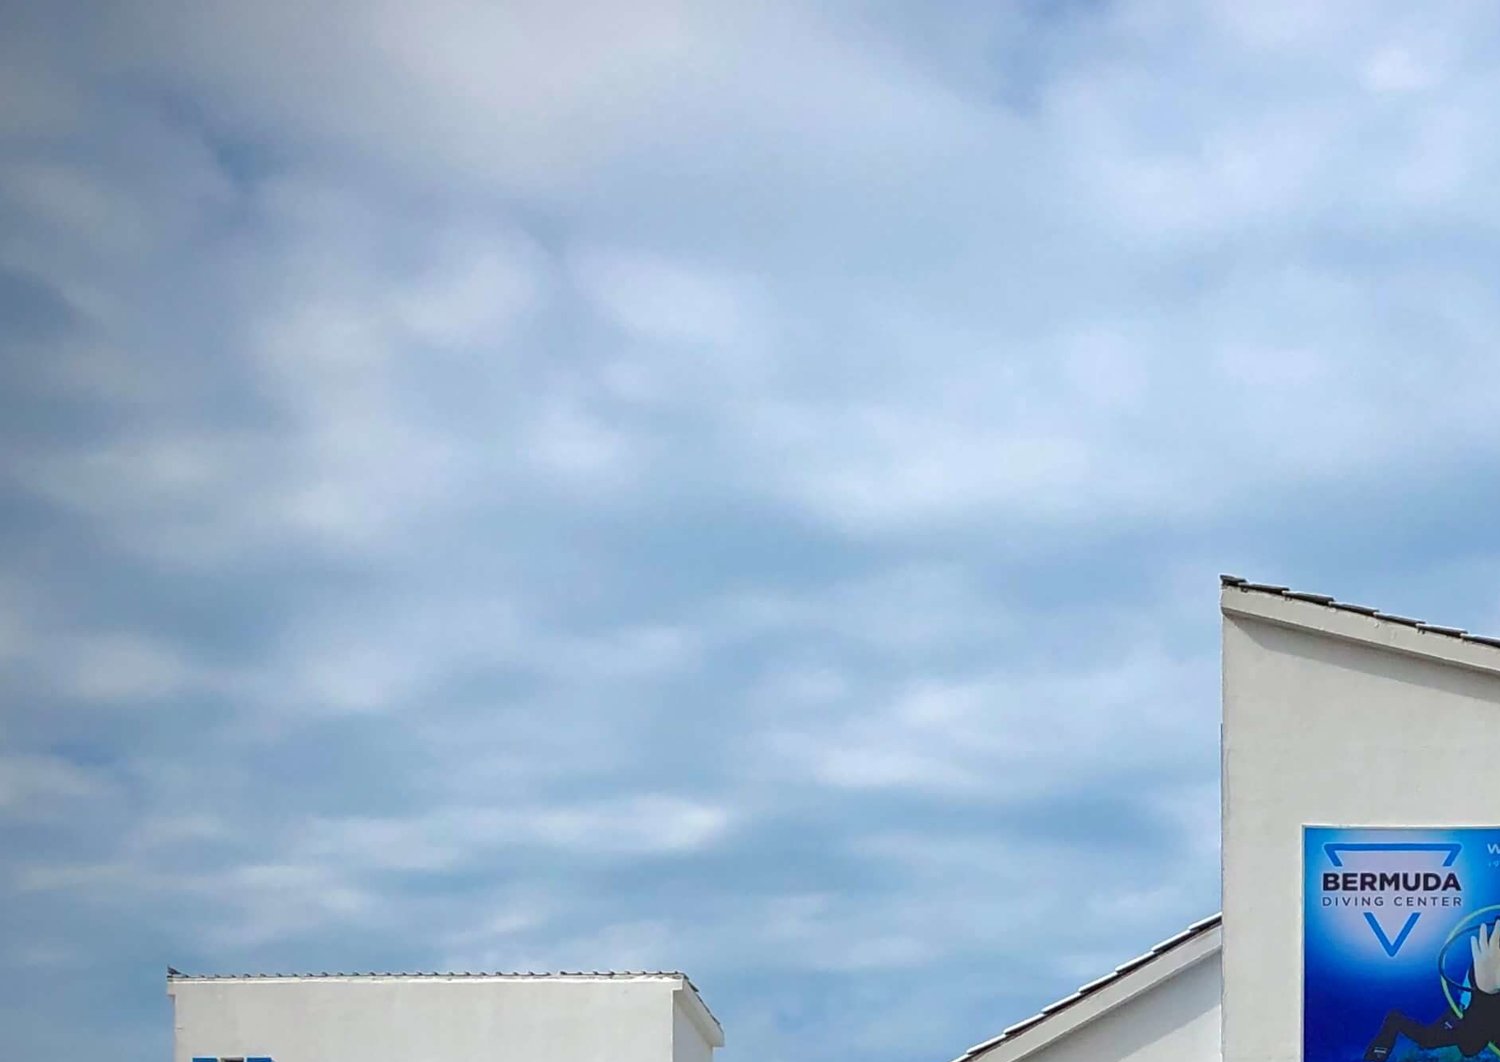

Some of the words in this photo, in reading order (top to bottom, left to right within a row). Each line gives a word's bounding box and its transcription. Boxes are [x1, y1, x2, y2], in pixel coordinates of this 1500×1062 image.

[1322, 872, 1462, 892] BERMUDA
[1322, 896, 1384, 907] DIVING
[1393, 896, 1462, 907] CENTER
